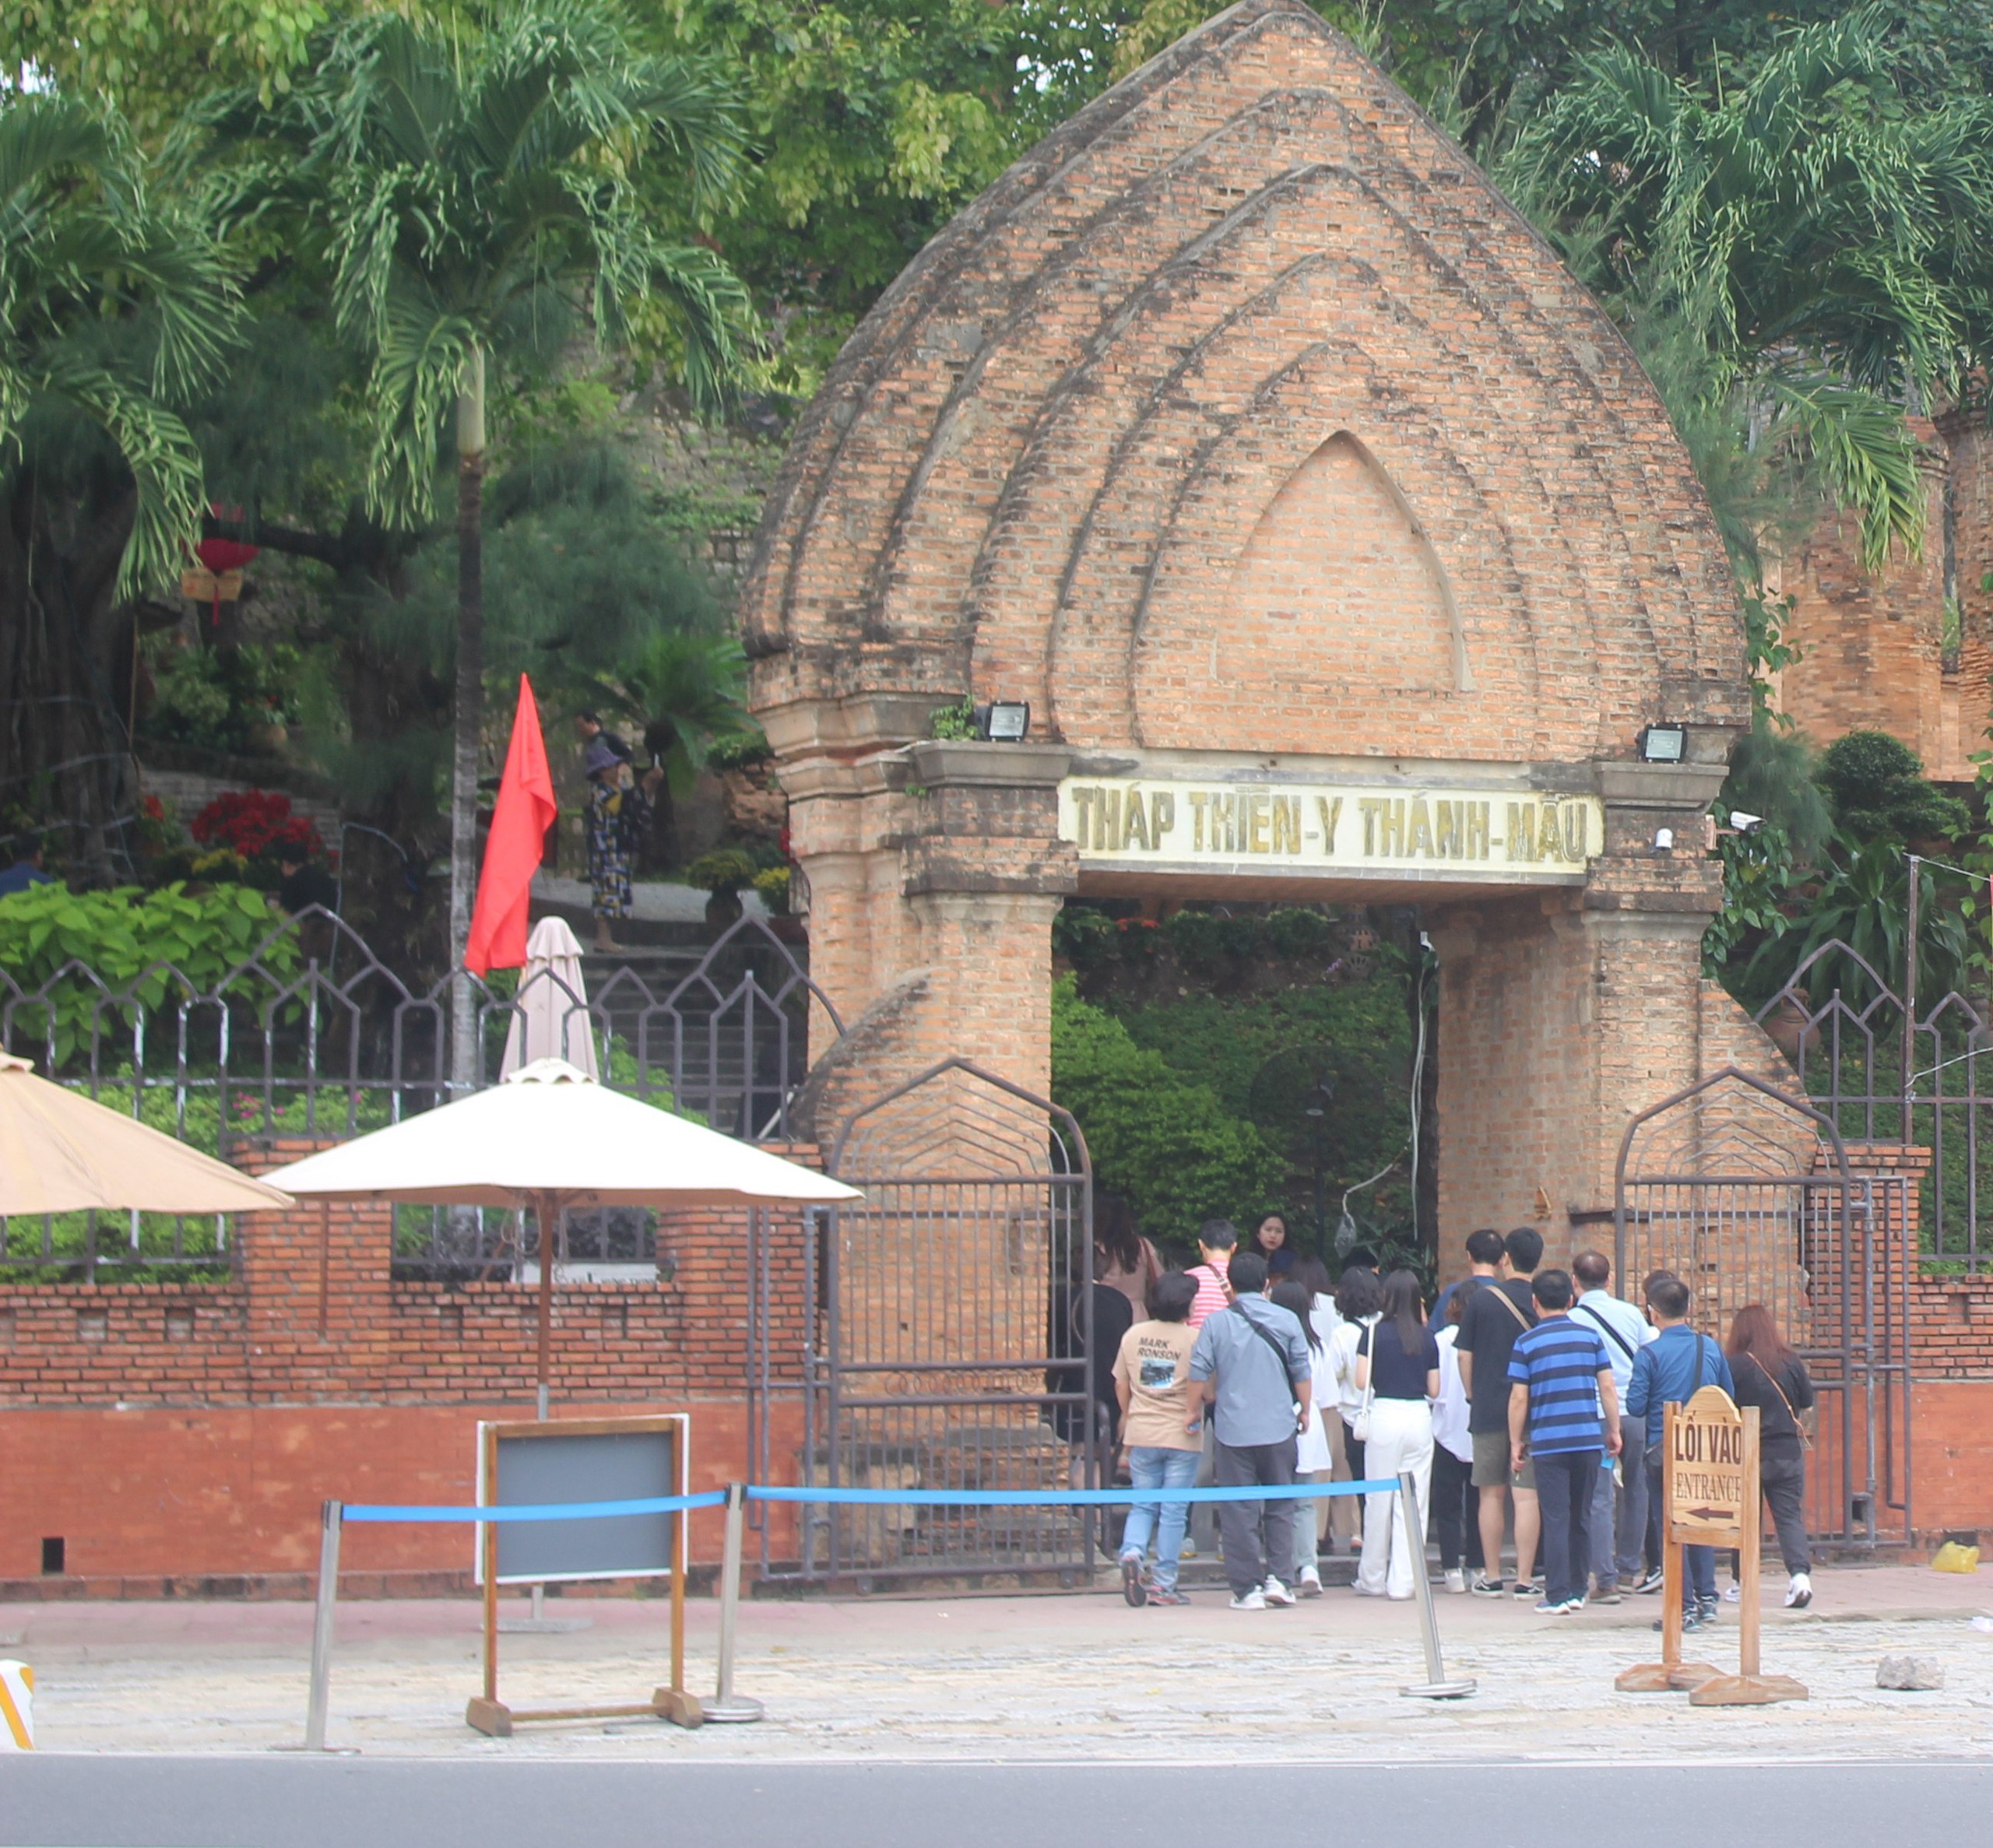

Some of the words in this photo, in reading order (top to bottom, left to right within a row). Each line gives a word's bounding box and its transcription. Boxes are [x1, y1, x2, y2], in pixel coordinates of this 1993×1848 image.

[1071, 781, 1176, 851] THÁP
[1137, 1347, 1181, 1361] RONSON
[1139, 1337, 1169, 1349] MARK
[1675, 1410, 1702, 1462] LỐI
[1708, 1417, 1742, 1465] VÀO
[1675, 1472, 1741, 1502] ENTRANCE
